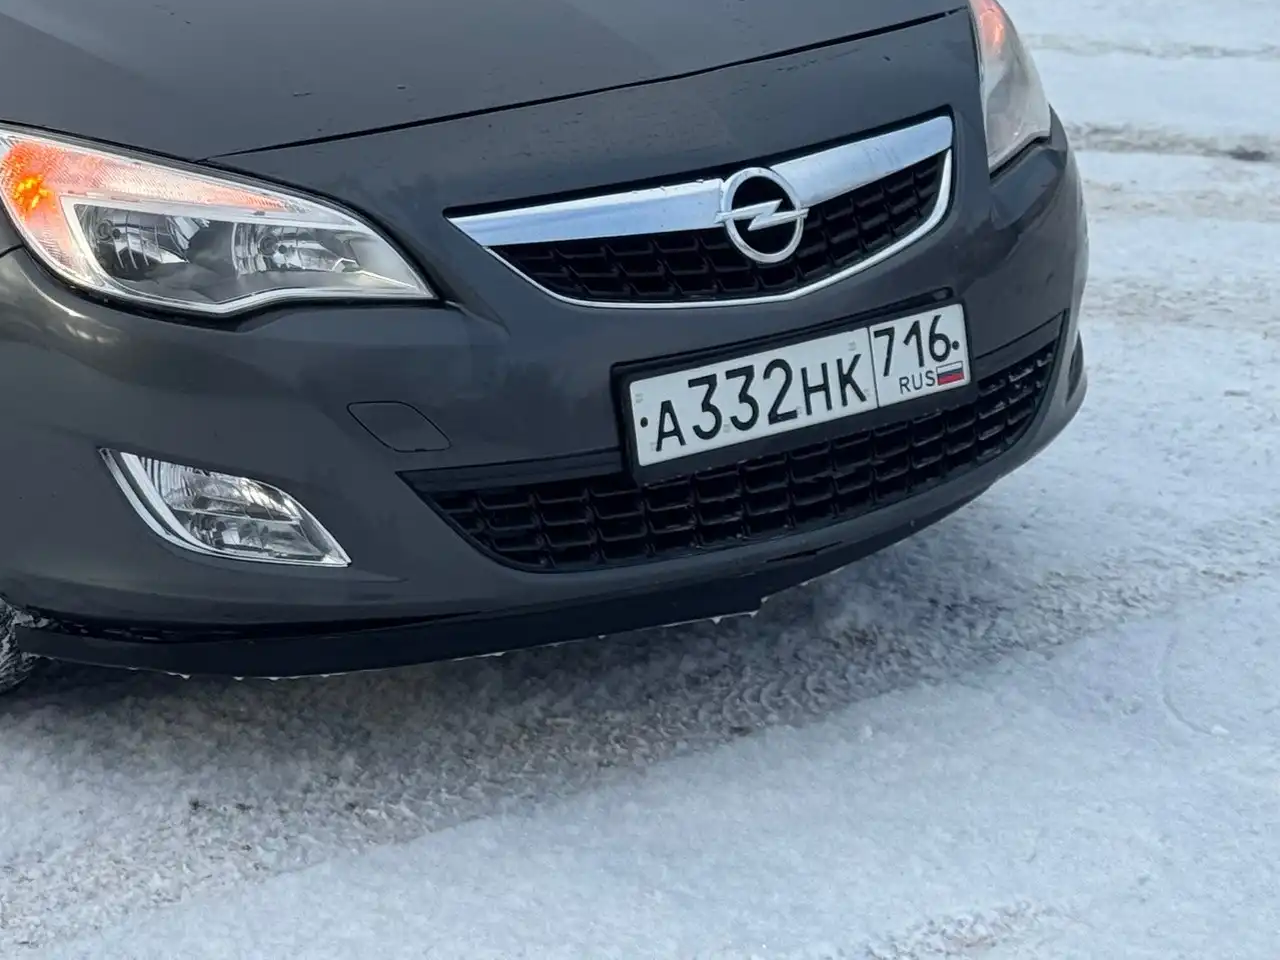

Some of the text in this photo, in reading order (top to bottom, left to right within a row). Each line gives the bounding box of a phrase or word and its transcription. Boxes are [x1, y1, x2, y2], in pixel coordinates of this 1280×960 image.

[655, 314, 951, 452] А332НК 716
[899, 370, 936, 395] RUS
